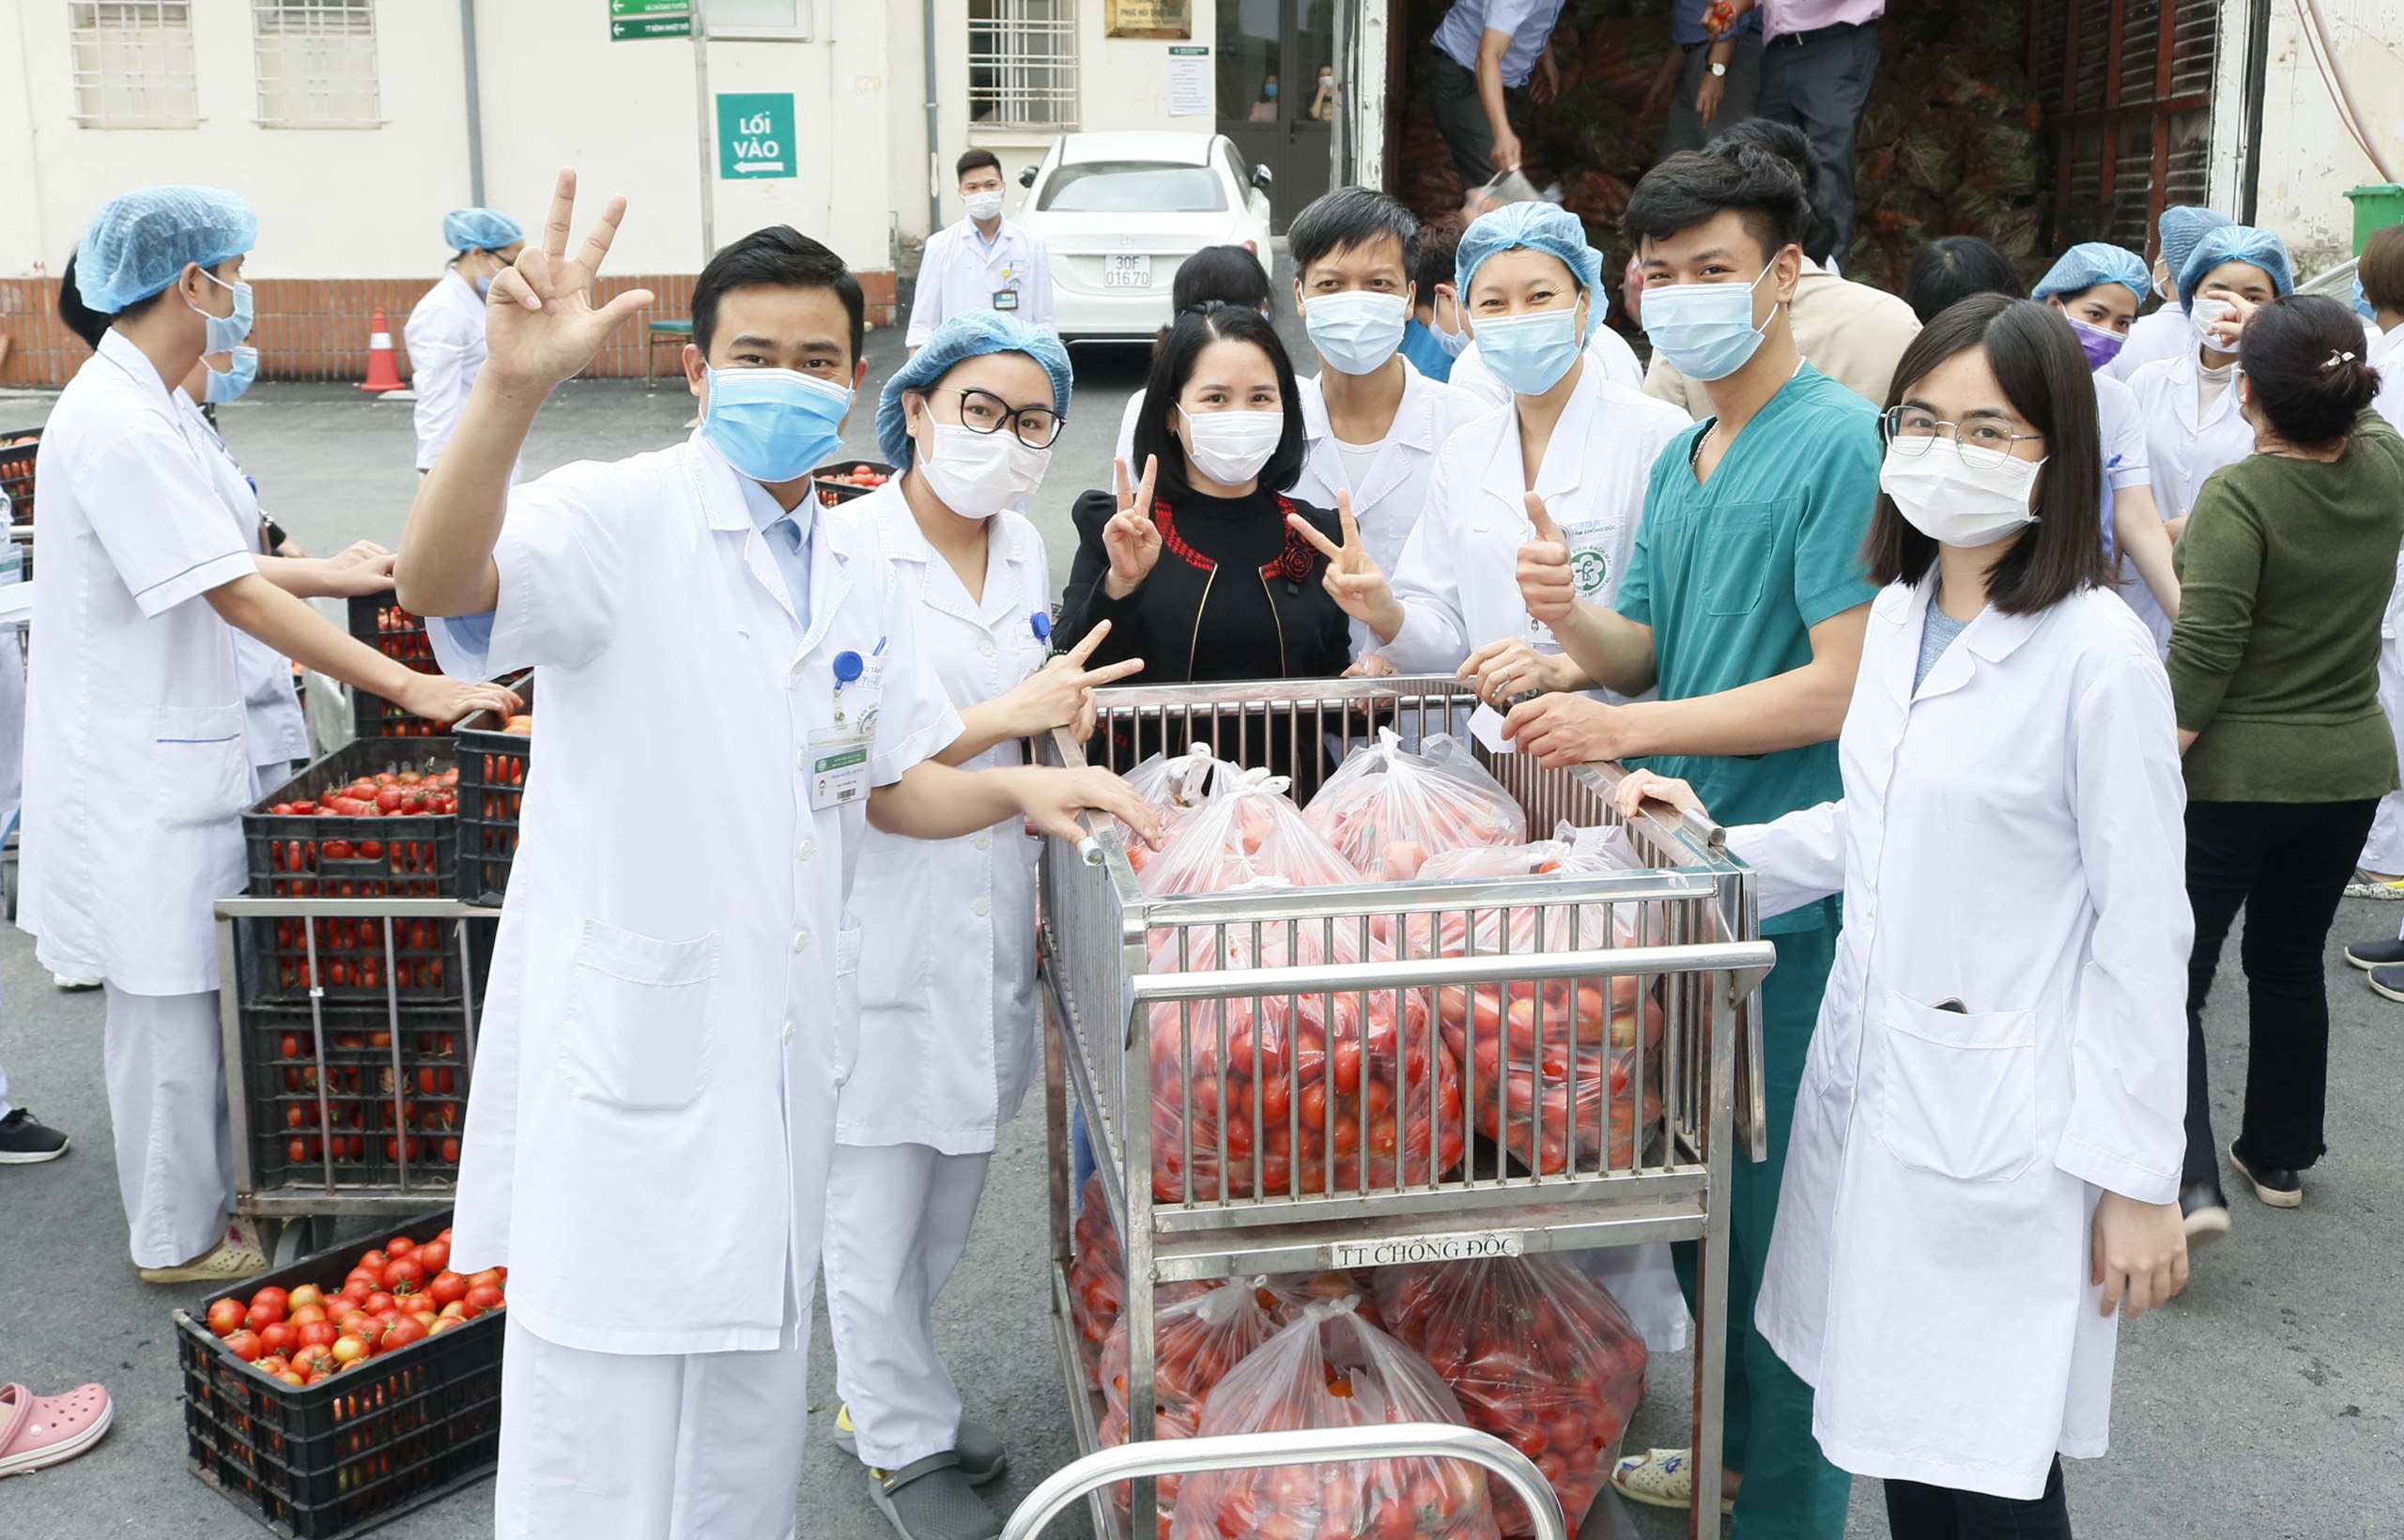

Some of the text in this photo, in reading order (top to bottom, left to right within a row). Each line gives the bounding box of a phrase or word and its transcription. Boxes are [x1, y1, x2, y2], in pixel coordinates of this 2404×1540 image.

[732, 136, 779, 158] VÀO
[1116, 255, 1140, 270] 30F
[1105, 271, 1149, 285] 016.70
[1588, 577, 1611, 597] HOSPITAL
[1339, 1248, 1367, 1265] TT
[1375, 1236, 1459, 1263] CHỐNG
